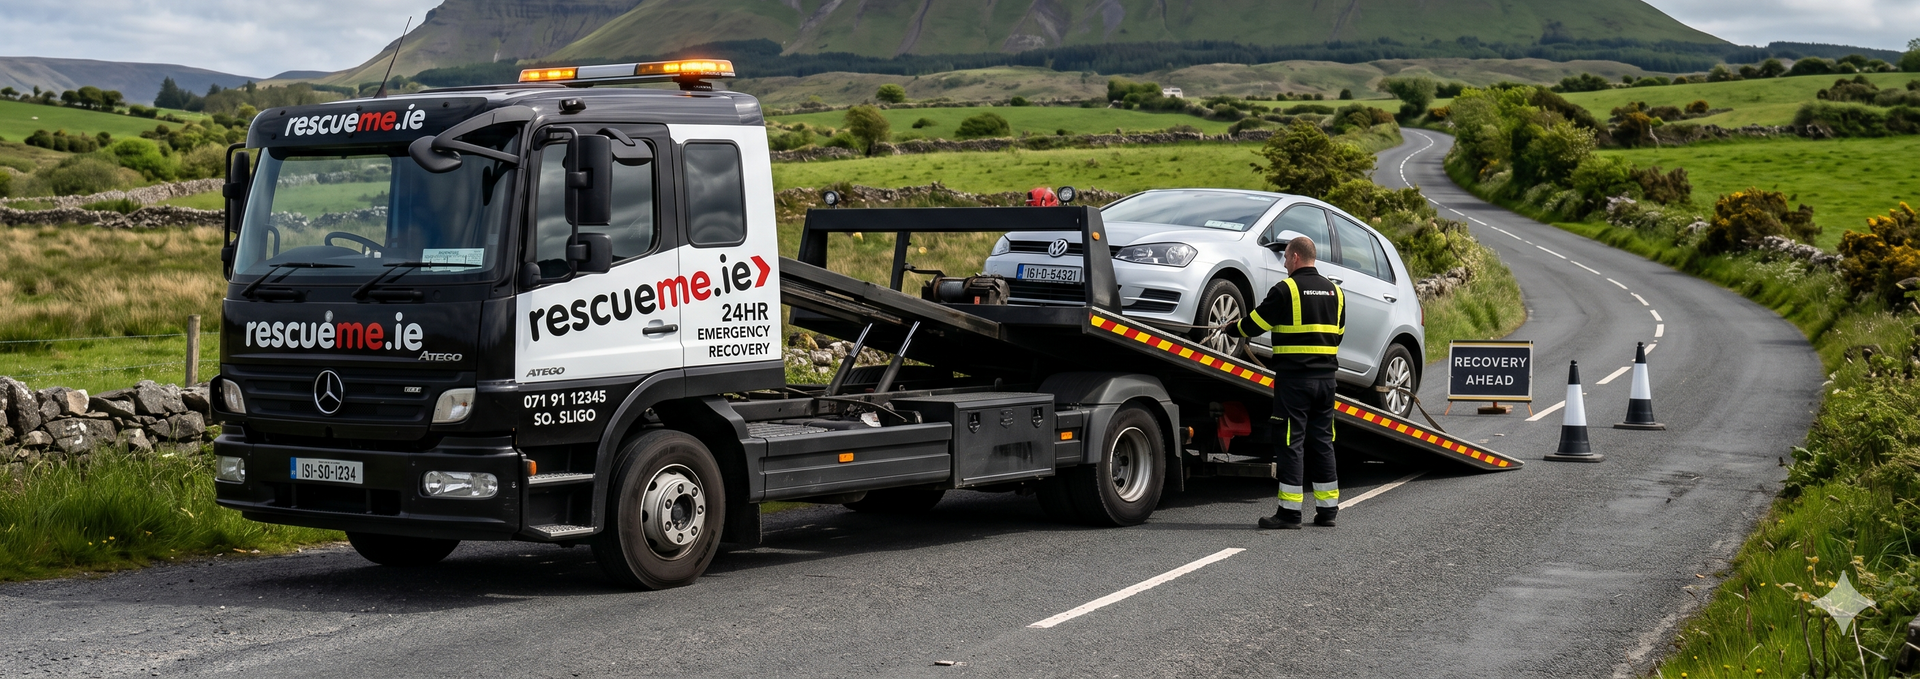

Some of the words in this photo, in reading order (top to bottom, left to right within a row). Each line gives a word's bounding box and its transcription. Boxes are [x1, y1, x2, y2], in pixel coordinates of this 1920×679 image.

[284, 103, 426, 137] rescueme.ie
[529, 253, 752, 342] rescueme.ie
[722, 302, 769, 322] 24HR
[245, 311, 424, 351] rescueme.ie
[698, 325, 771, 341] EMERGENCY
[418, 351, 463, 362] ATEGO
[709, 342, 771, 358] RECOVERY
[1454, 356, 1528, 368] RECOVERY
[526, 366, 566, 377] ATEGO
[1465, 374, 1515, 386] AHEAD
[523, 395, 546, 409] 071
[551, 393, 565, 407] 91
[570, 390, 607, 405] 12345
[534, 412, 556, 426] SO.
[559, 409, 596, 424] SLIGO
